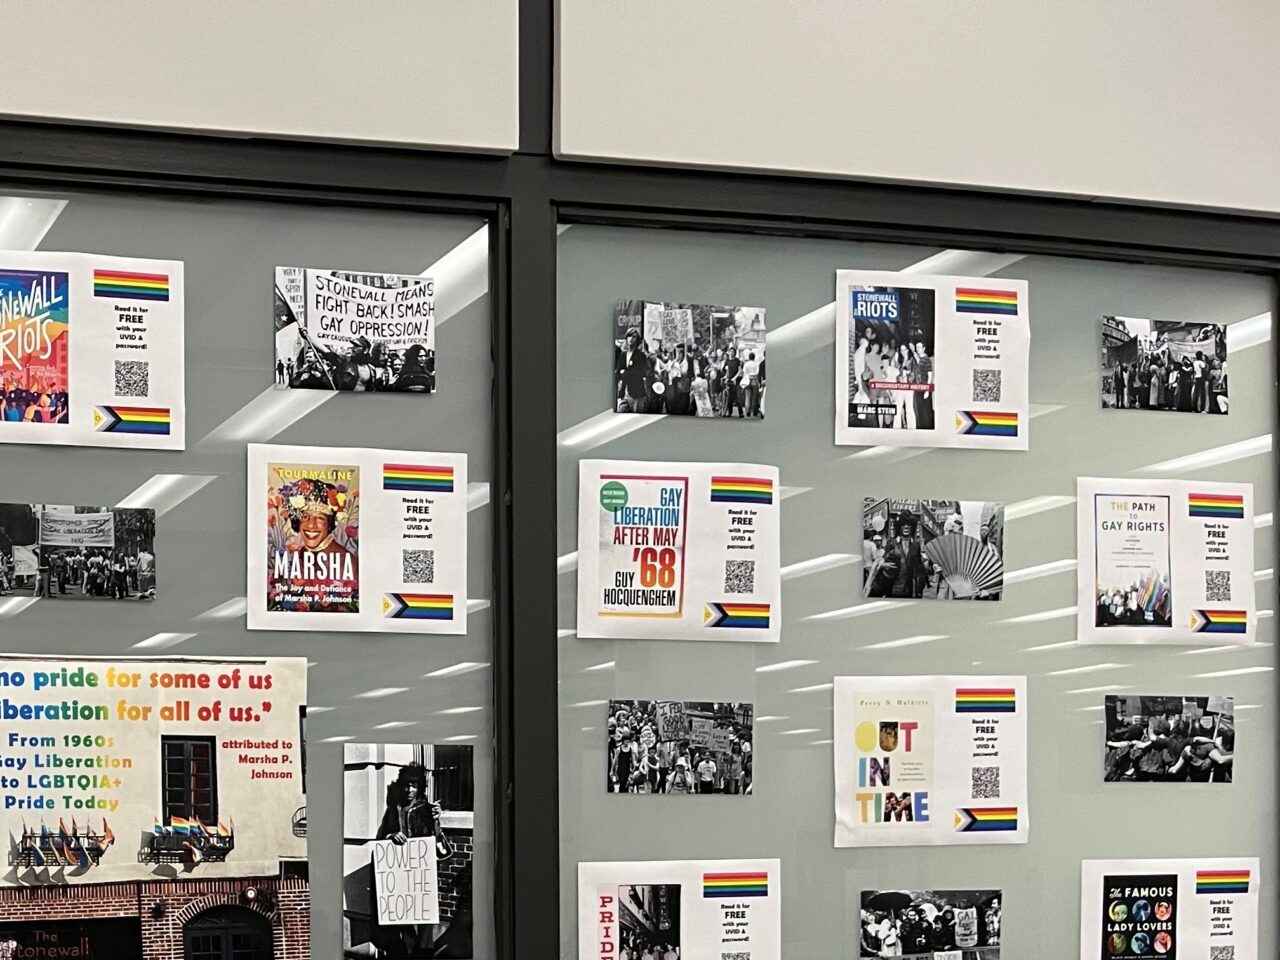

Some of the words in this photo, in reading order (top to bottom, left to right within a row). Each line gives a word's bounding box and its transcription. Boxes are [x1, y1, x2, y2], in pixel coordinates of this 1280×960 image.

[316, 275, 386, 301] STONEWALL
[395, 282, 433, 301] MEANS
[316, 294, 349, 314] FIGHT
[356, 304, 394, 318] BACK!
[398, 302, 434, 317] SMASH
[857, 302, 897, 318] RIOTS
[614, 507, 679, 526] LIBERATION
[1102, 521, 1122, 531] GAY
[1127, 522, 1165, 531] RIGHTS
[614, 527, 649, 545] AFTER
[653, 528, 678, 547] MAY
[274, 551, 354, 580] MARSHA
[290, 585, 303, 593] Joy
[34, 667, 98, 690] pride
[106, 668, 141, 688] for
[149, 670, 210, 689] some
[218, 668, 241, 689] of
[248, 673, 272, 690] us
[117, 700, 152, 721] for
[160, 701, 190, 722] all
[197, 701, 222, 722] of
[229, 701, 272, 723] us.”
[222, 740, 272, 750] attributed
[281, 740, 293, 750] to
[855, 721, 918, 752] OUT
[34, 754, 132, 768] Liberation
[859, 757, 890, 787] IN
[4, 796, 55, 809] Pride
[63, 796, 120, 812] Today
[856, 792, 929, 822] TIME
[376, 840, 428, 869] POWER
[378, 872, 396, 893] TO
[405, 869, 431, 892] THE
[379, 894, 431, 921] PEOPLE
[725, 911, 746, 919] FREE
[1108, 923, 1133, 931] LADY
[1137, 923, 1172, 931] LOVERS
